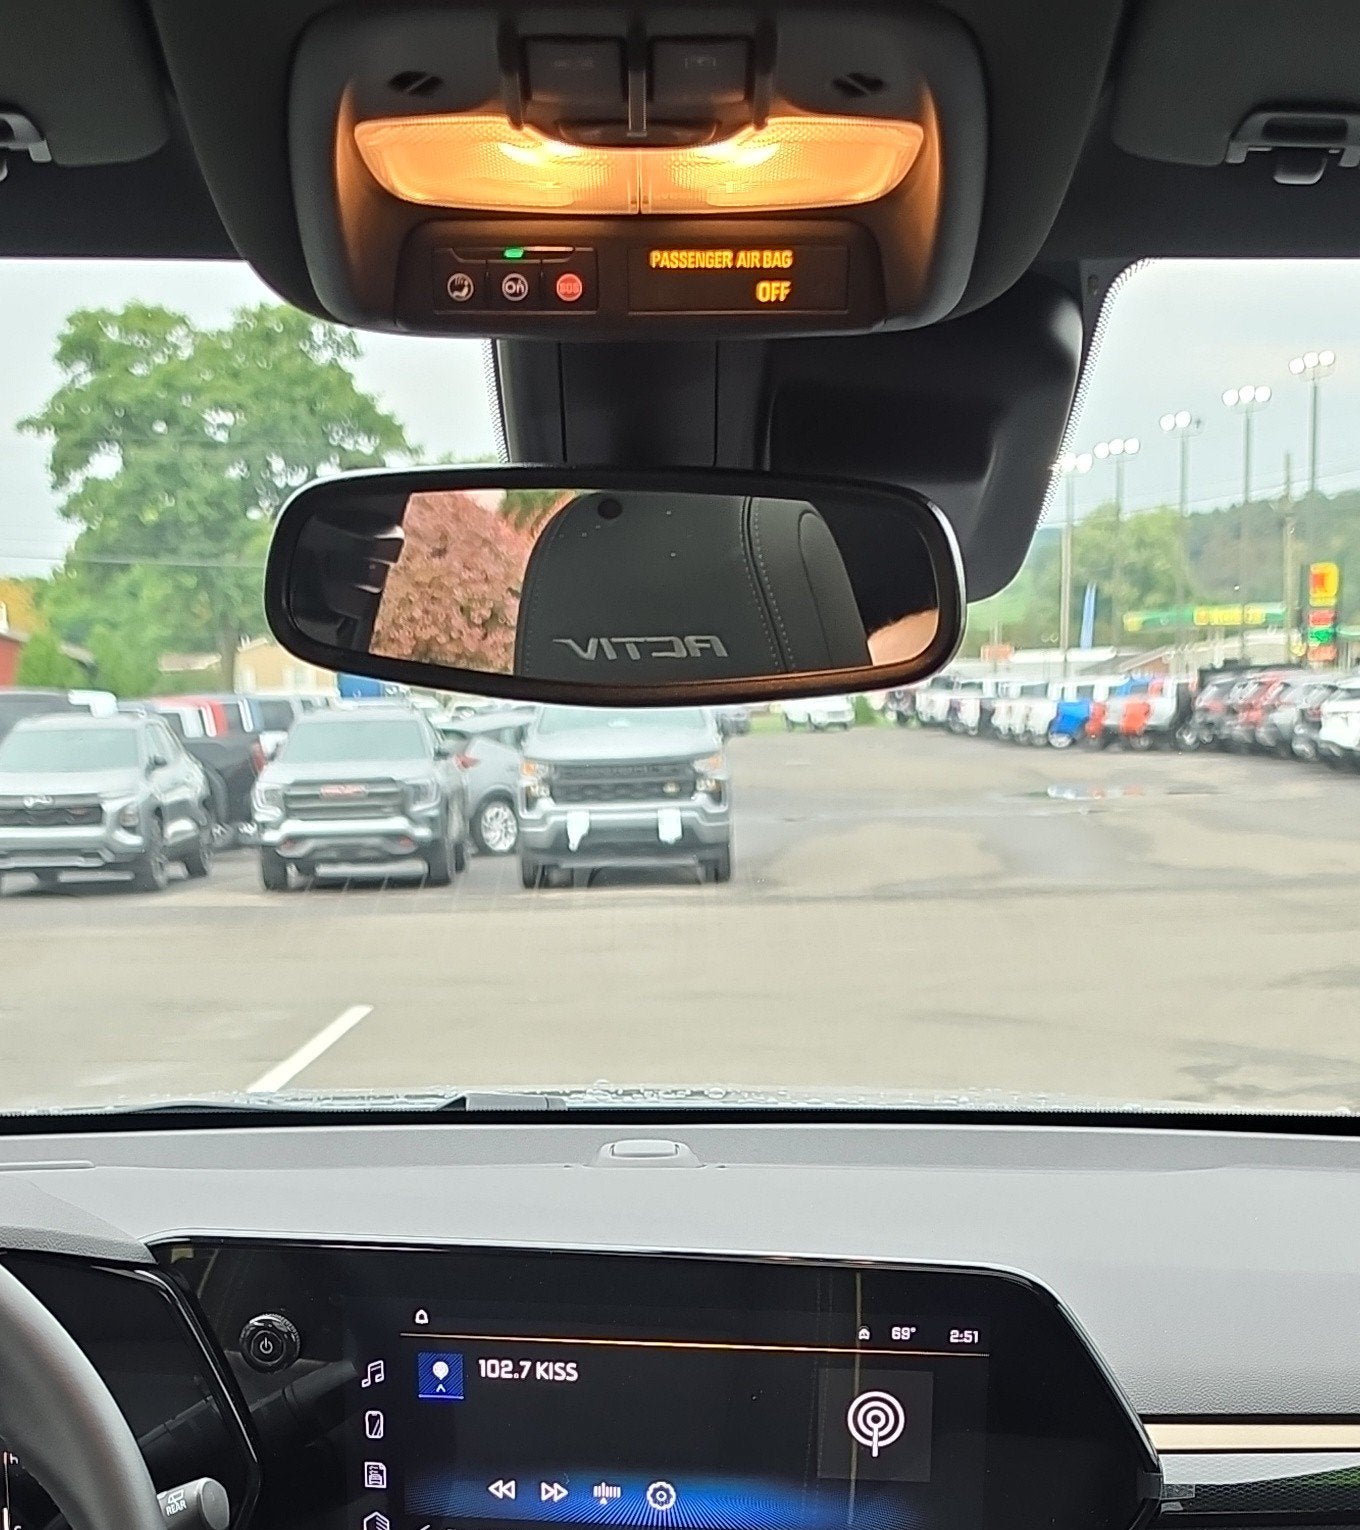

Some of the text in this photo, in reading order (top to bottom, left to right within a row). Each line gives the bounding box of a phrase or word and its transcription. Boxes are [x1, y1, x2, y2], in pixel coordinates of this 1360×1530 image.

[650, 250, 793, 269] PASSENGER AIR BAG
[756, 281, 791, 302] OFF
[949, 1329, 979, 1344] 2:51
[478, 1359, 579, 1382] 102.7 KISS
[165, 1500, 187, 1517] REAR
